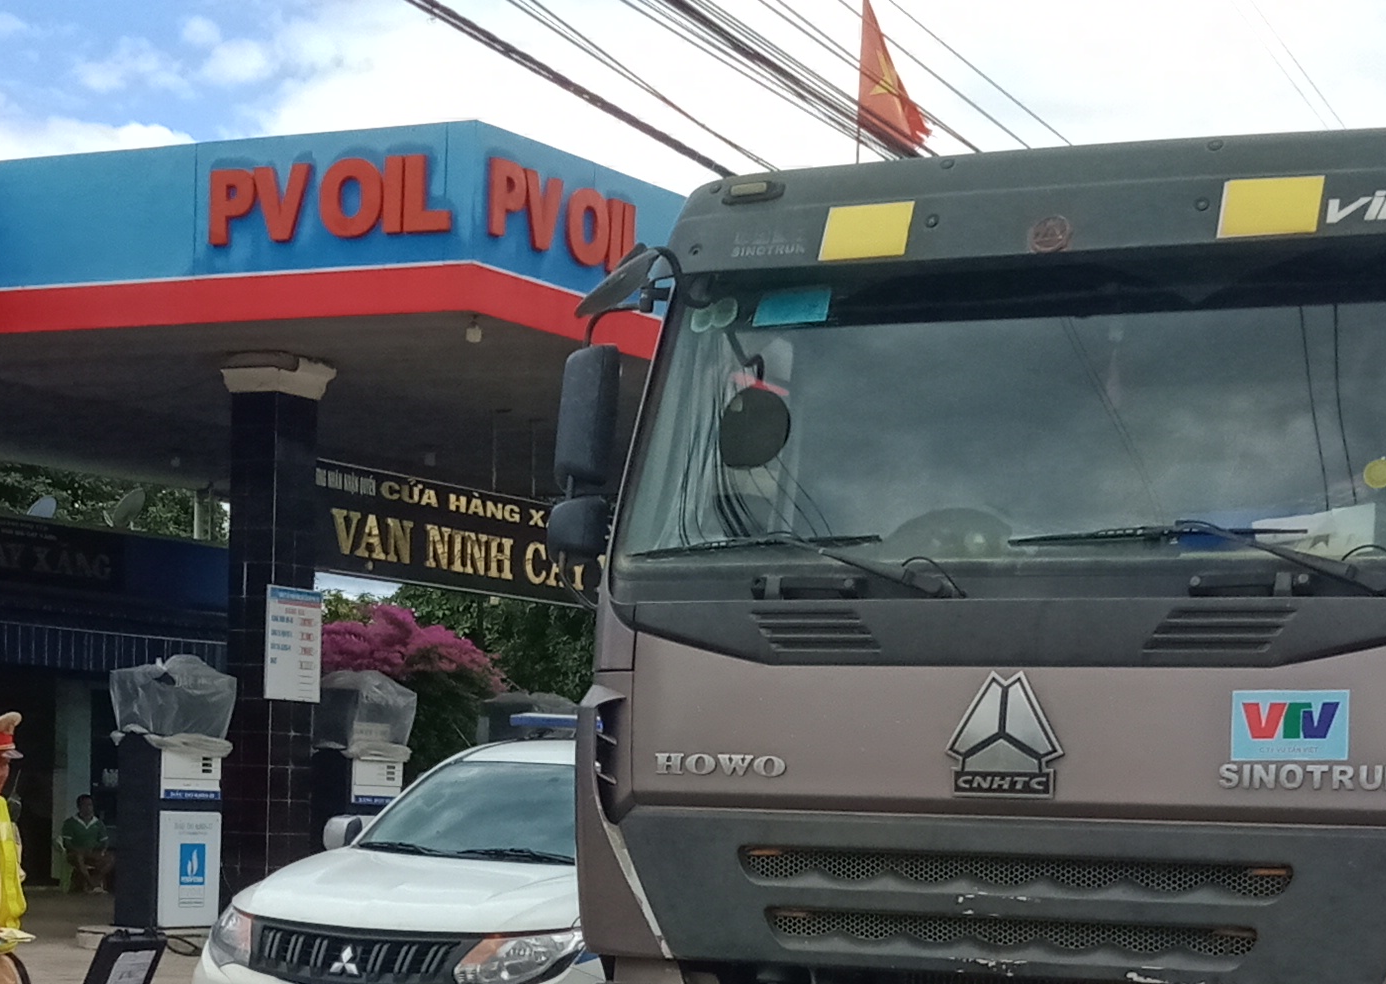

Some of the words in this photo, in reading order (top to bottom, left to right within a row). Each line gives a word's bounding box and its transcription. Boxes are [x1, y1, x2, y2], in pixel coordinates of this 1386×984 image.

[208, 162, 313, 247] PV
[319, 153, 453, 239] OIL
[487, 156, 564, 253] PV
[379, 477, 439, 508] CỬA
[448, 492, 521, 524] HÀNG
[331, 507, 414, 571] VẠN
[424, 523, 514, 580] NINH
[1241, 701, 1341, 740] VTV
[655, 752, 787, 777] HOWO
[956, 775, 1047, 790] CNHTC
